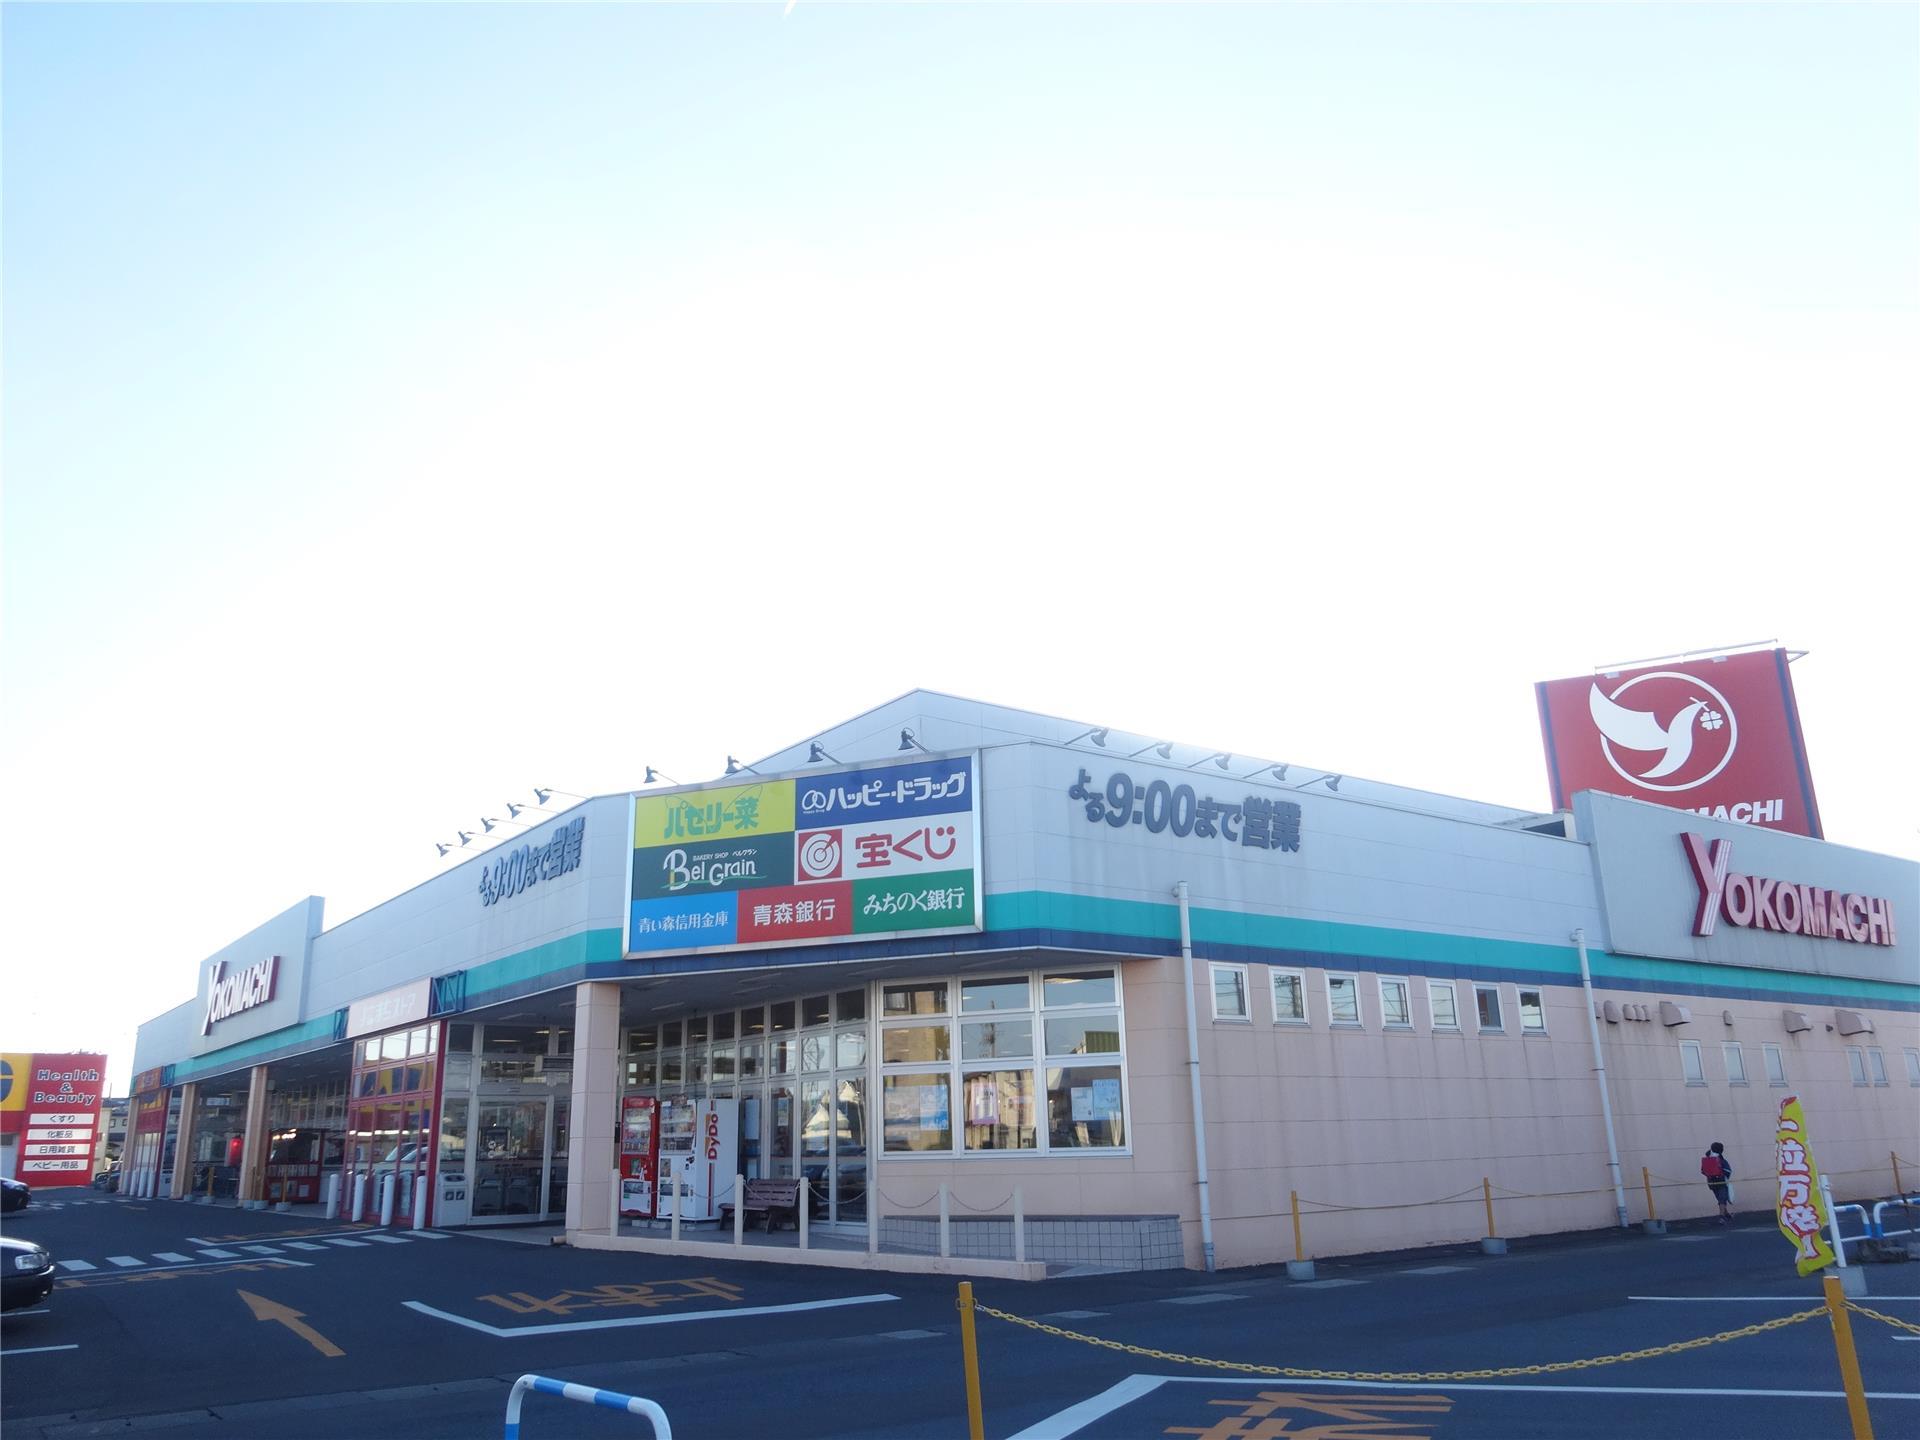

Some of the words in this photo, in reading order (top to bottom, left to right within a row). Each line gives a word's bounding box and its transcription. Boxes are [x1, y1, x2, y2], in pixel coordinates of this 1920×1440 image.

[714, 851, 729, 859] SHOP
[855, 826, 957, 869] 宝くじ
[663, 848, 705, 891] Bel
[708, 858, 757, 886] Grain
[1680, 832, 1896, 947] YOKOMACHI
[863, 887, 966, 916] みちのく銀行
[753, 898, 836, 927] 青森銀行
[639, 911, 729, 933] 青い森信用金庫
[201, 955, 281, 1036] YOKOMACHI
[37, 1069, 99, 1081] Health
[60, 1082, 74, 1093] &
[34, 1091, 96, 1106] Beauty
[49, 1114, 76, 1123] くすり
[47, 1130, 74, 1139] 化粧品
[39, 1145, 76, 1154] 日用雑貨
[32, 1161, 80, 1170] ベビー用品
